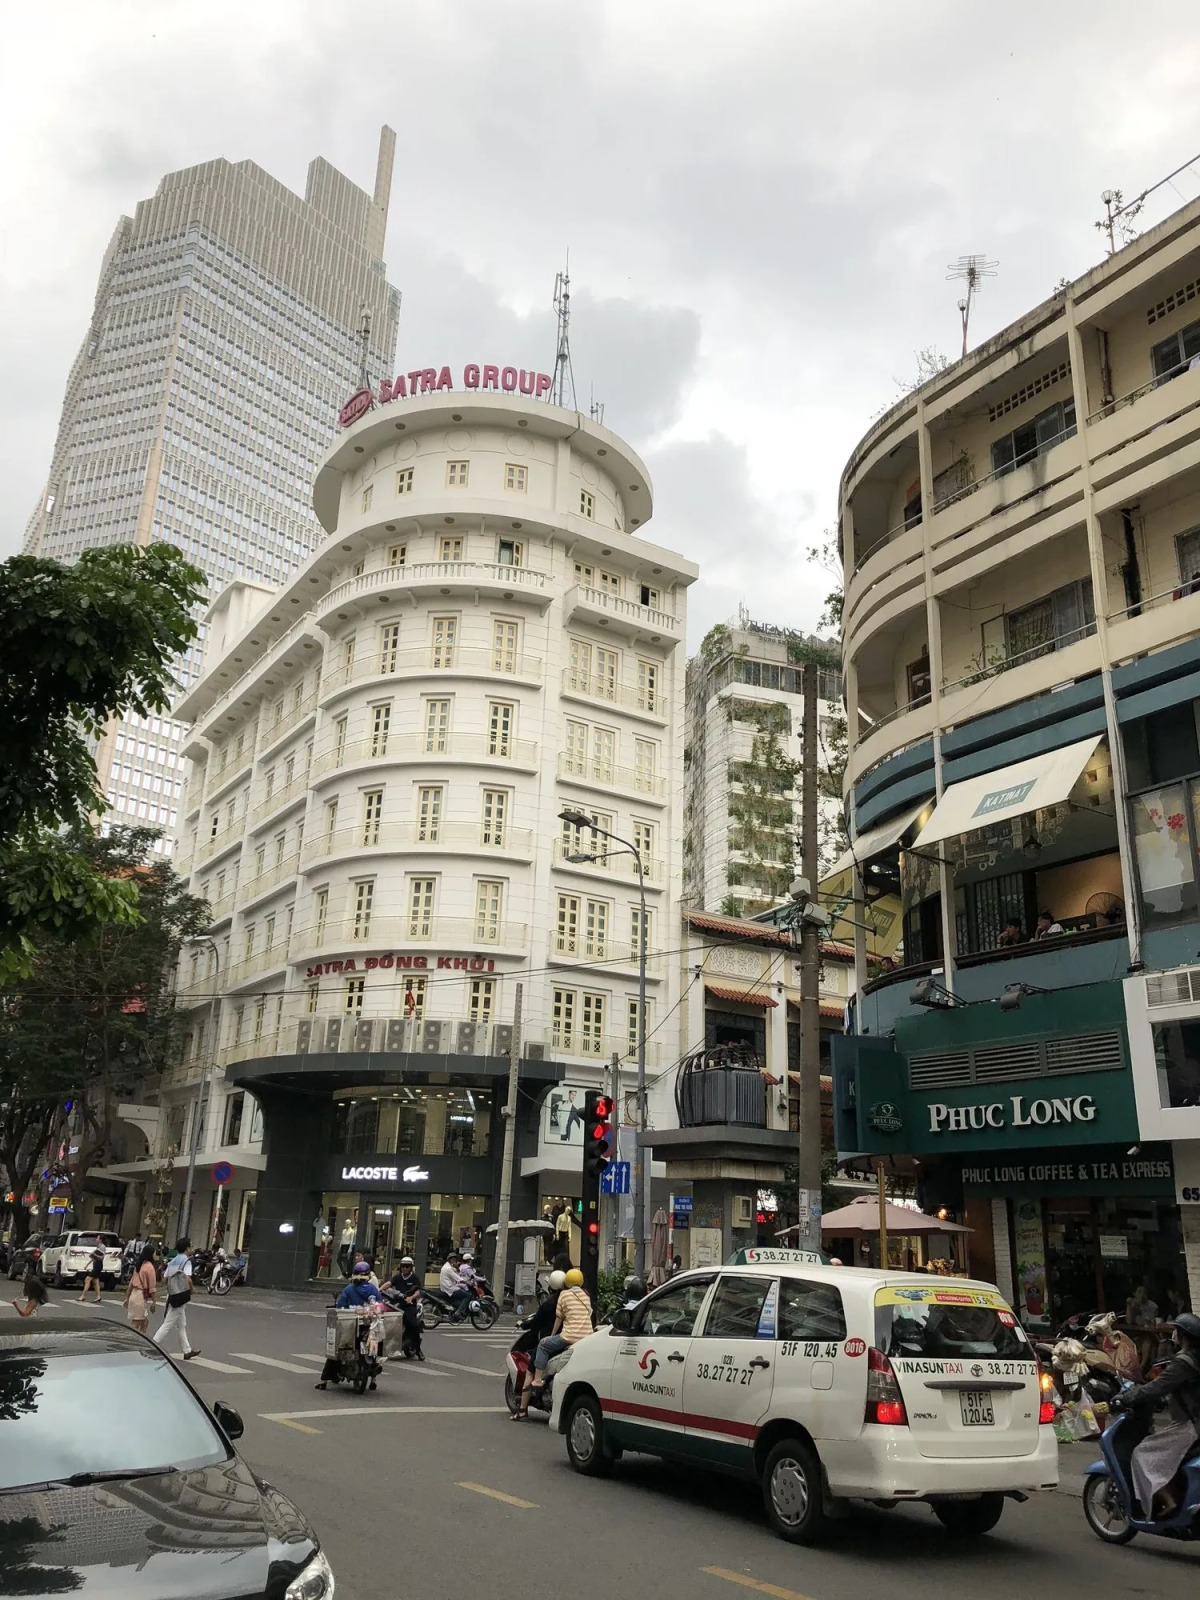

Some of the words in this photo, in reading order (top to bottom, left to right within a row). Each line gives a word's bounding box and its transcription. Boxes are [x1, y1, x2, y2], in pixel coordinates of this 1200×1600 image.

[379, 366, 453, 402] SATRA
[464, 364, 552, 396] GROUP
[983, 785, 1031, 808] KATINAT
[307, 959, 356, 977] SATRA
[927, 1104, 1004, 1131] PHUC
[1010, 1095, 1096, 1126] LONG
[342, 1167, 398, 1180] LACOSTE
[962, 1168, 991, 1182] PHUC
[994, 1166, 1025, 1182] LONG
[1028, 1164, 1074, 1181] COFFEE
[1078, 1164, 1089, 1180] &
[1091, 1163, 1118, 1179] TEA
[1122, 1161, 1171, 1179] EXPRESS
[763, 1250, 789, 1261] 38.27
[793, 1252, 803, 1262] 27
[806, 1254, 817, 1263] 27
[781, 1342, 798, 1356] 51F
[803, 1342, 838, 1358] 120.45
[845, 1341, 865, 1353] 8016
[697, 1363, 724, 1381] 38.27
[726, 1367, 739, 1383] 27
[740, 1369, 753, 1385] 27
[988, 1362, 1014, 1375] 38.27
[1017, 1363, 1027, 1375] 27
[1030, 1364, 1038, 1376] 27
[968, 1393, 983, 1407] 51F
[964, 1408, 993, 1423] 120.45
